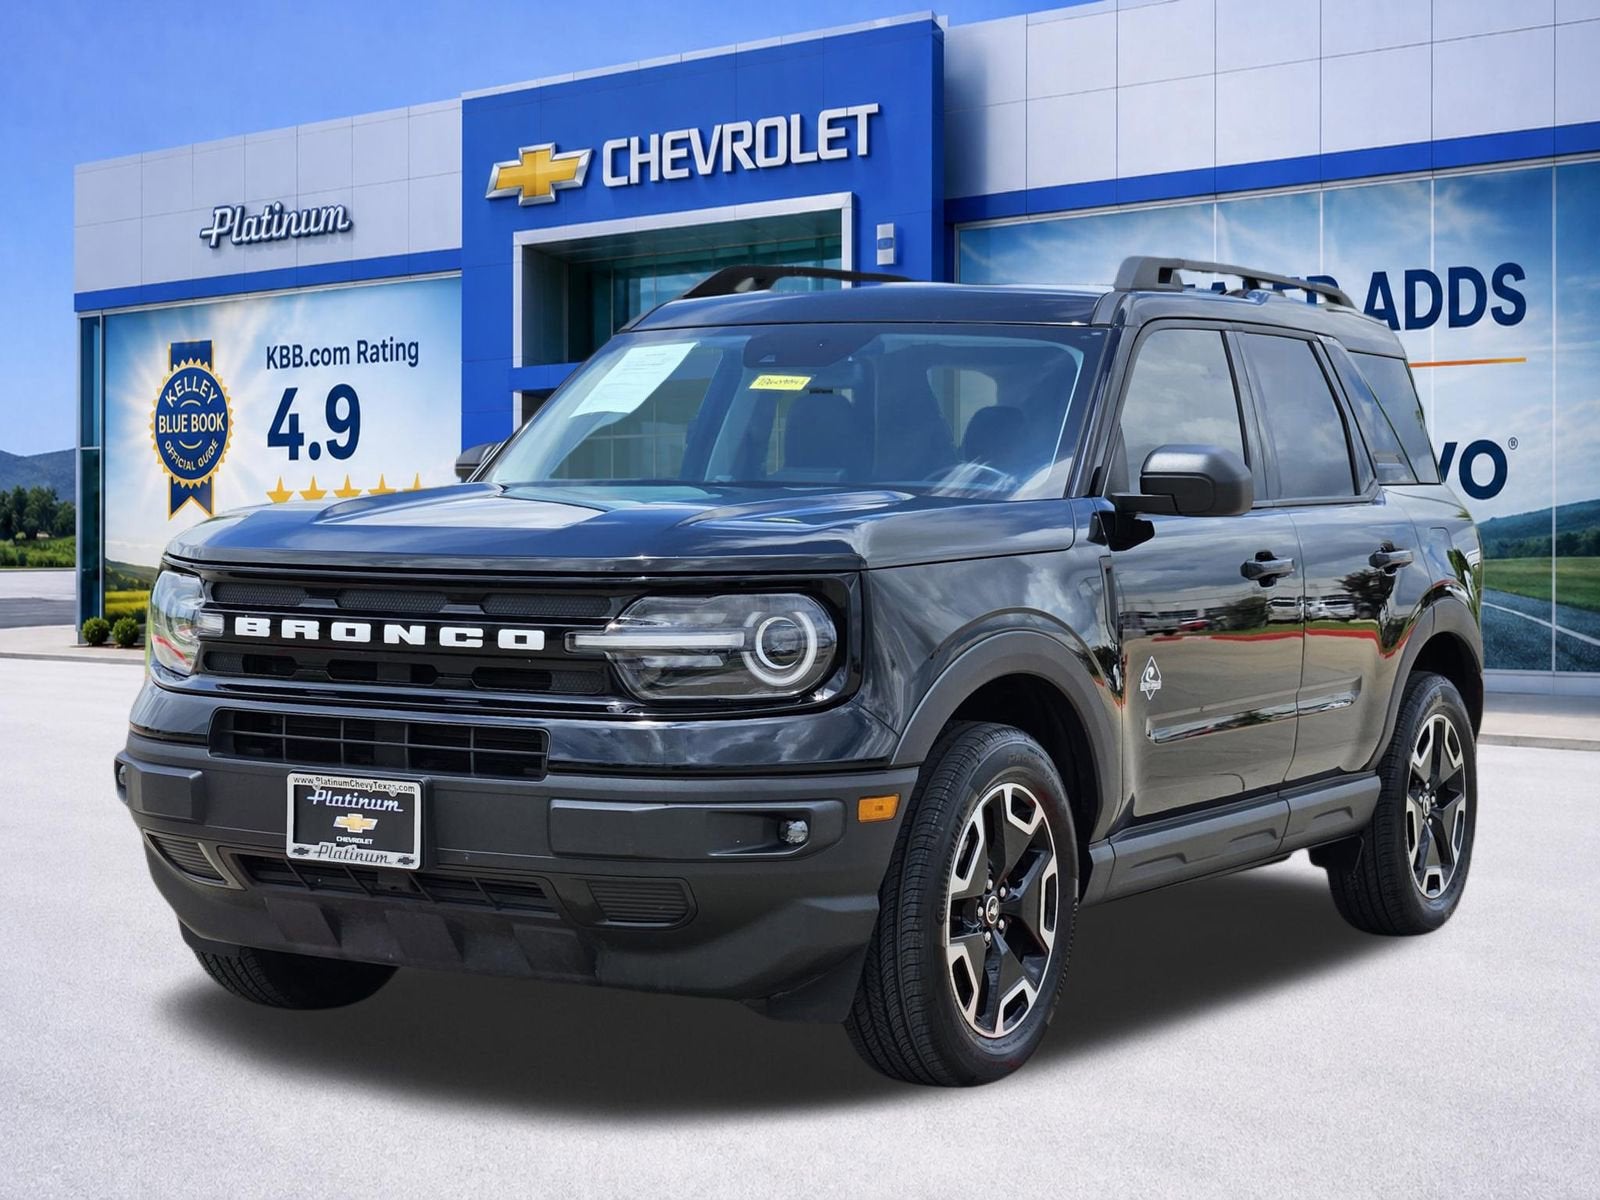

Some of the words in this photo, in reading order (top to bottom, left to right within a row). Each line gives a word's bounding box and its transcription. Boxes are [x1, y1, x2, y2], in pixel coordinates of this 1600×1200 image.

[603, 103, 879, 187] CHEVROLET
[201, 202, 351, 248] Platinum
[1362, 262, 1527, 331] ADDS
[266, 344, 350, 370] KBB.com
[357, 337, 419, 367] Rating
[165, 376, 218, 407] KELLEY
[159, 414, 188, 433] BLUE
[191, 412, 225, 432] BOOK
[266, 383, 361, 461] 4.9
[164, 440, 196, 471] OFFICIAL
[198, 438, 219, 468] GUIDE
[235, 617, 545, 650] BRONCO
[293, 776, 415, 793] wwwPlatinumChevyTexa.com
[307, 789, 404, 812] Platinum
[313, 844, 394, 865] Platinum
